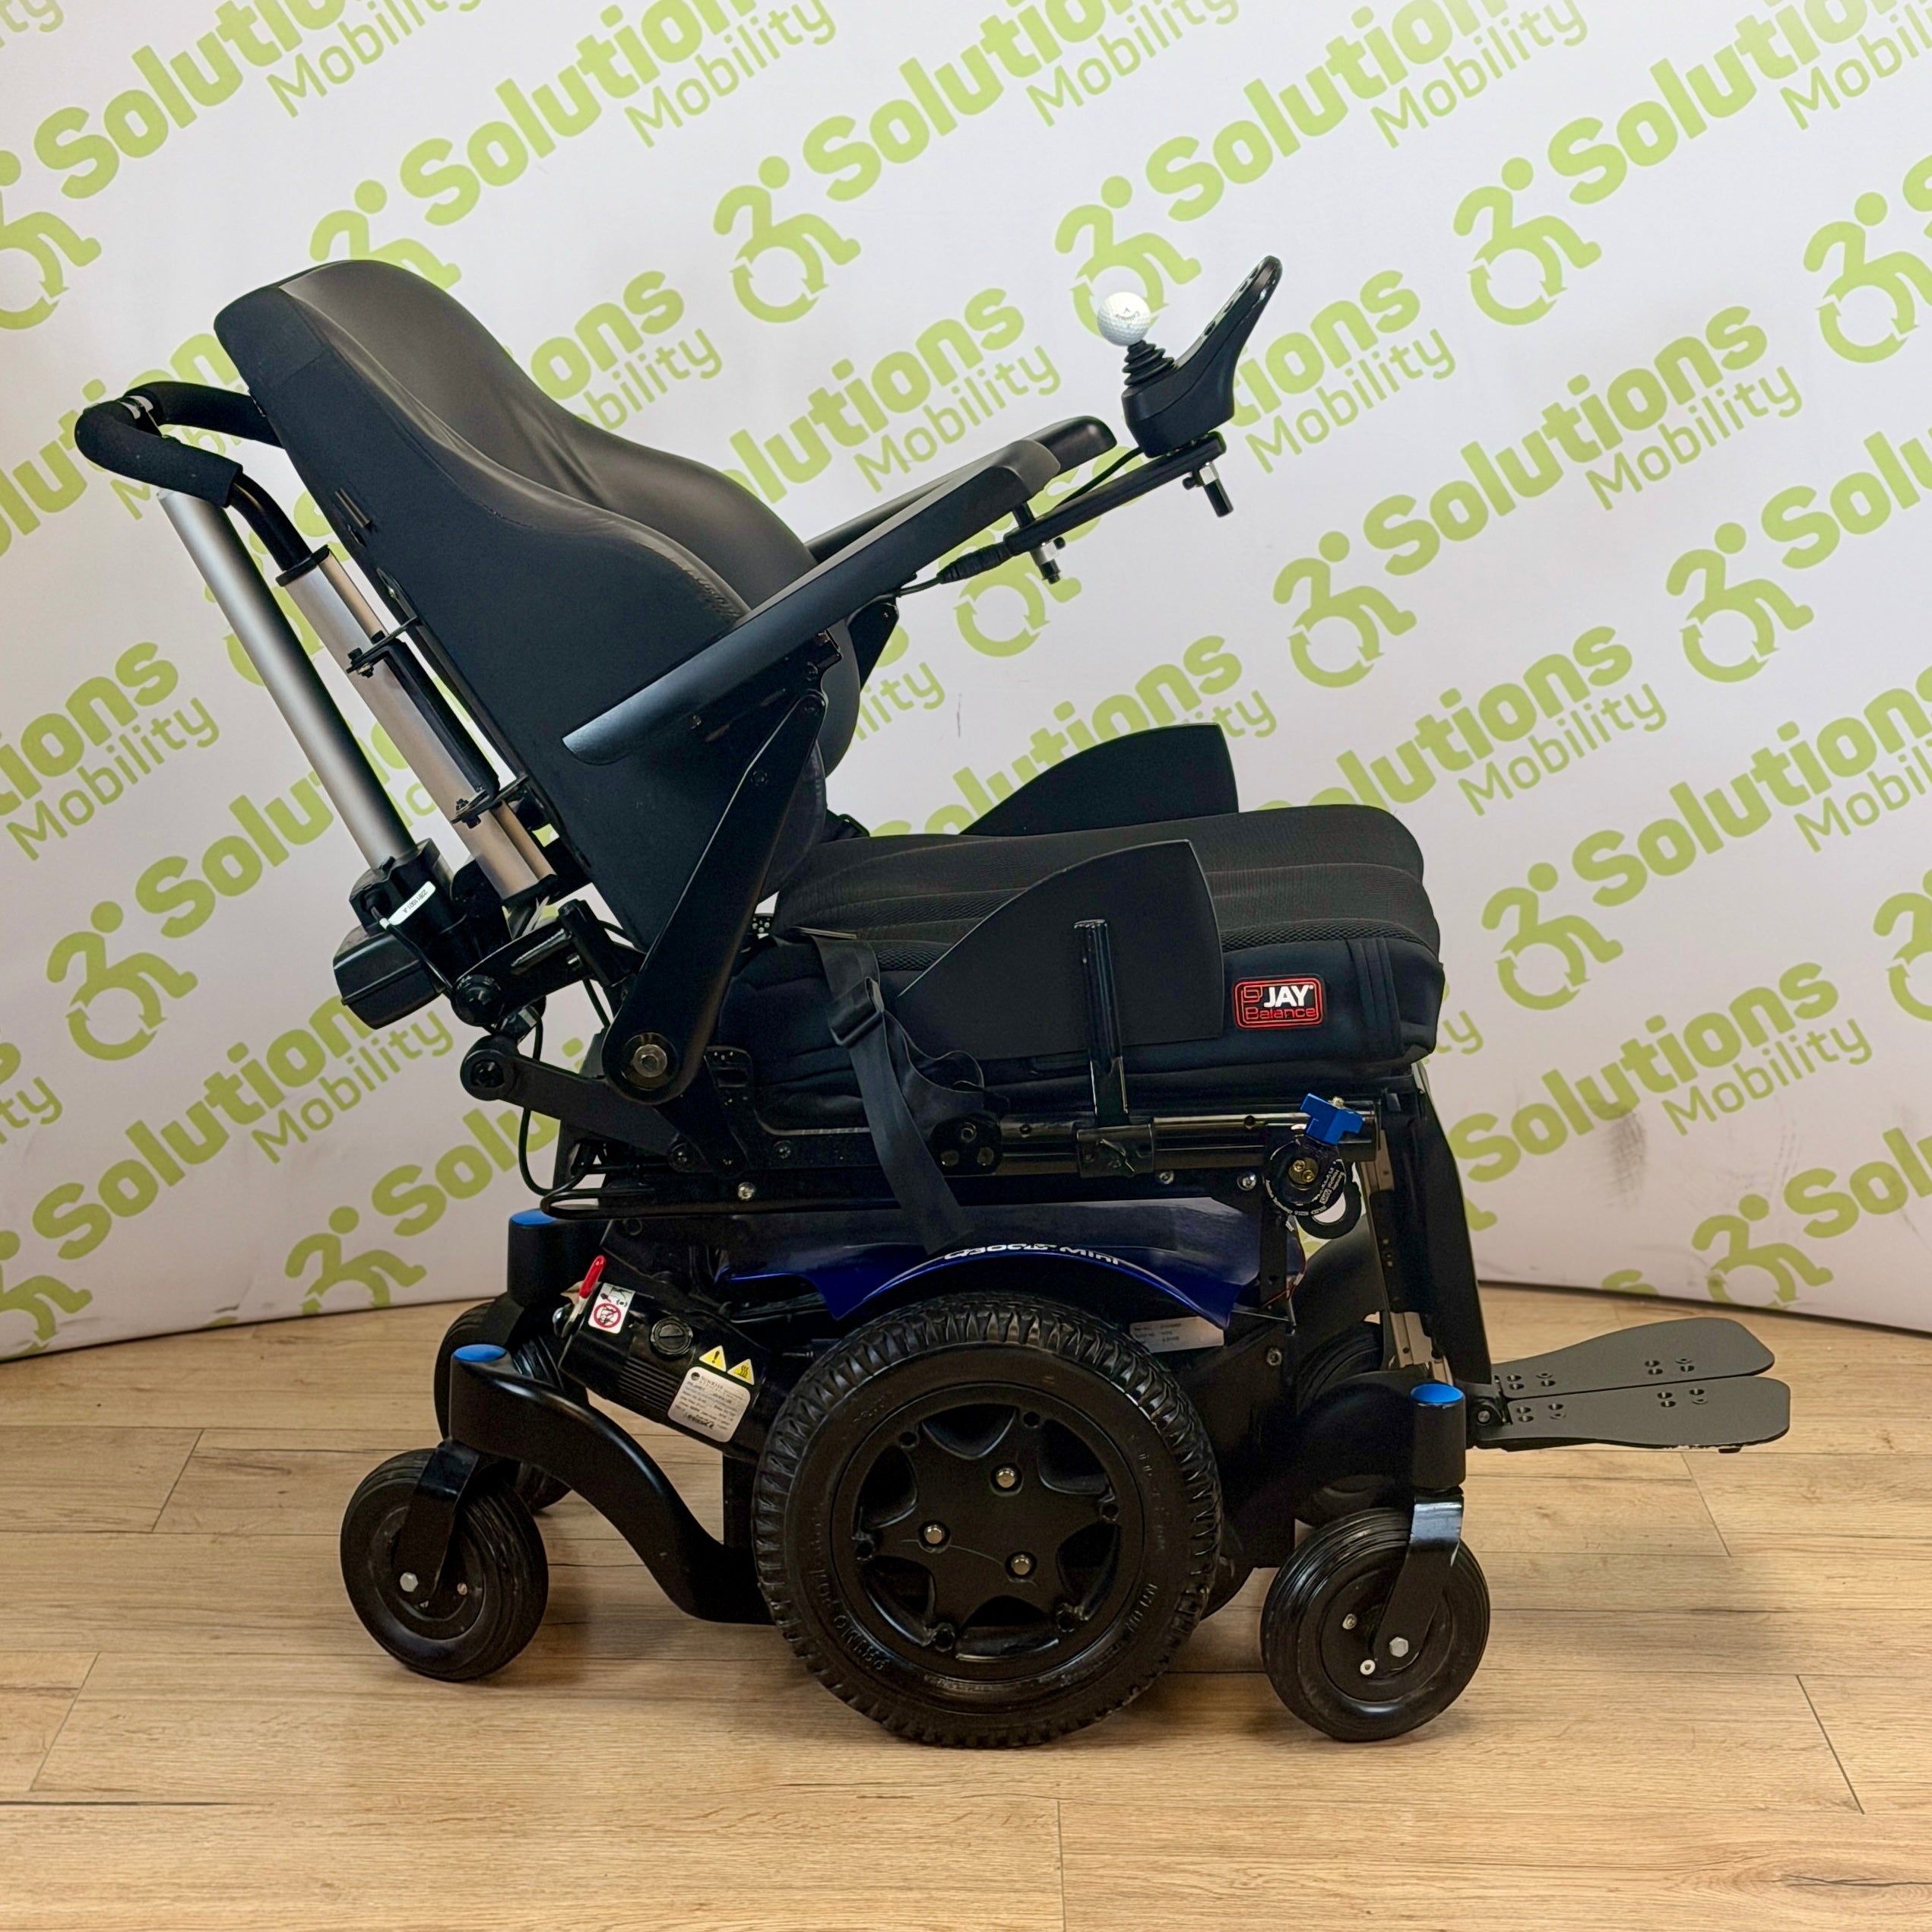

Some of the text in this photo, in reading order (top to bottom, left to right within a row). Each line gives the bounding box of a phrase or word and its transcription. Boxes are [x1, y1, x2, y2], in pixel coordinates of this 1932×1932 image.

[624, 0, 837, 147] Mobility
[803, 0, 1133, 201] Solutio
[1370, 0, 1589, 147] Mobility
[1547, 0, 1898, 204] Solutio
[719, 289, 1024, 505] lutions
[853, 347, 1060, 493] Mobility
[1245, 330, 1456, 473] Mobility
[1363, 306, 1768, 575] Solutions
[1585, 366, 1803, 511] Mobility
[5, 697, 220, 861] Mobility
[1457, 683, 1668, 816] Mobility
[1571, 664, 1932, 907] Solution
[1793, 739, 1932, 853] Mobil
[1245, 1006, 1316, 1020] Balance
[1263, 984, 1310, 1008] JAY
[250, 1010, 454, 1164] Mobility
[1446, 962, 1839, 1183] Solutions
[1660, 1019, 1873, 1135] Mobility
